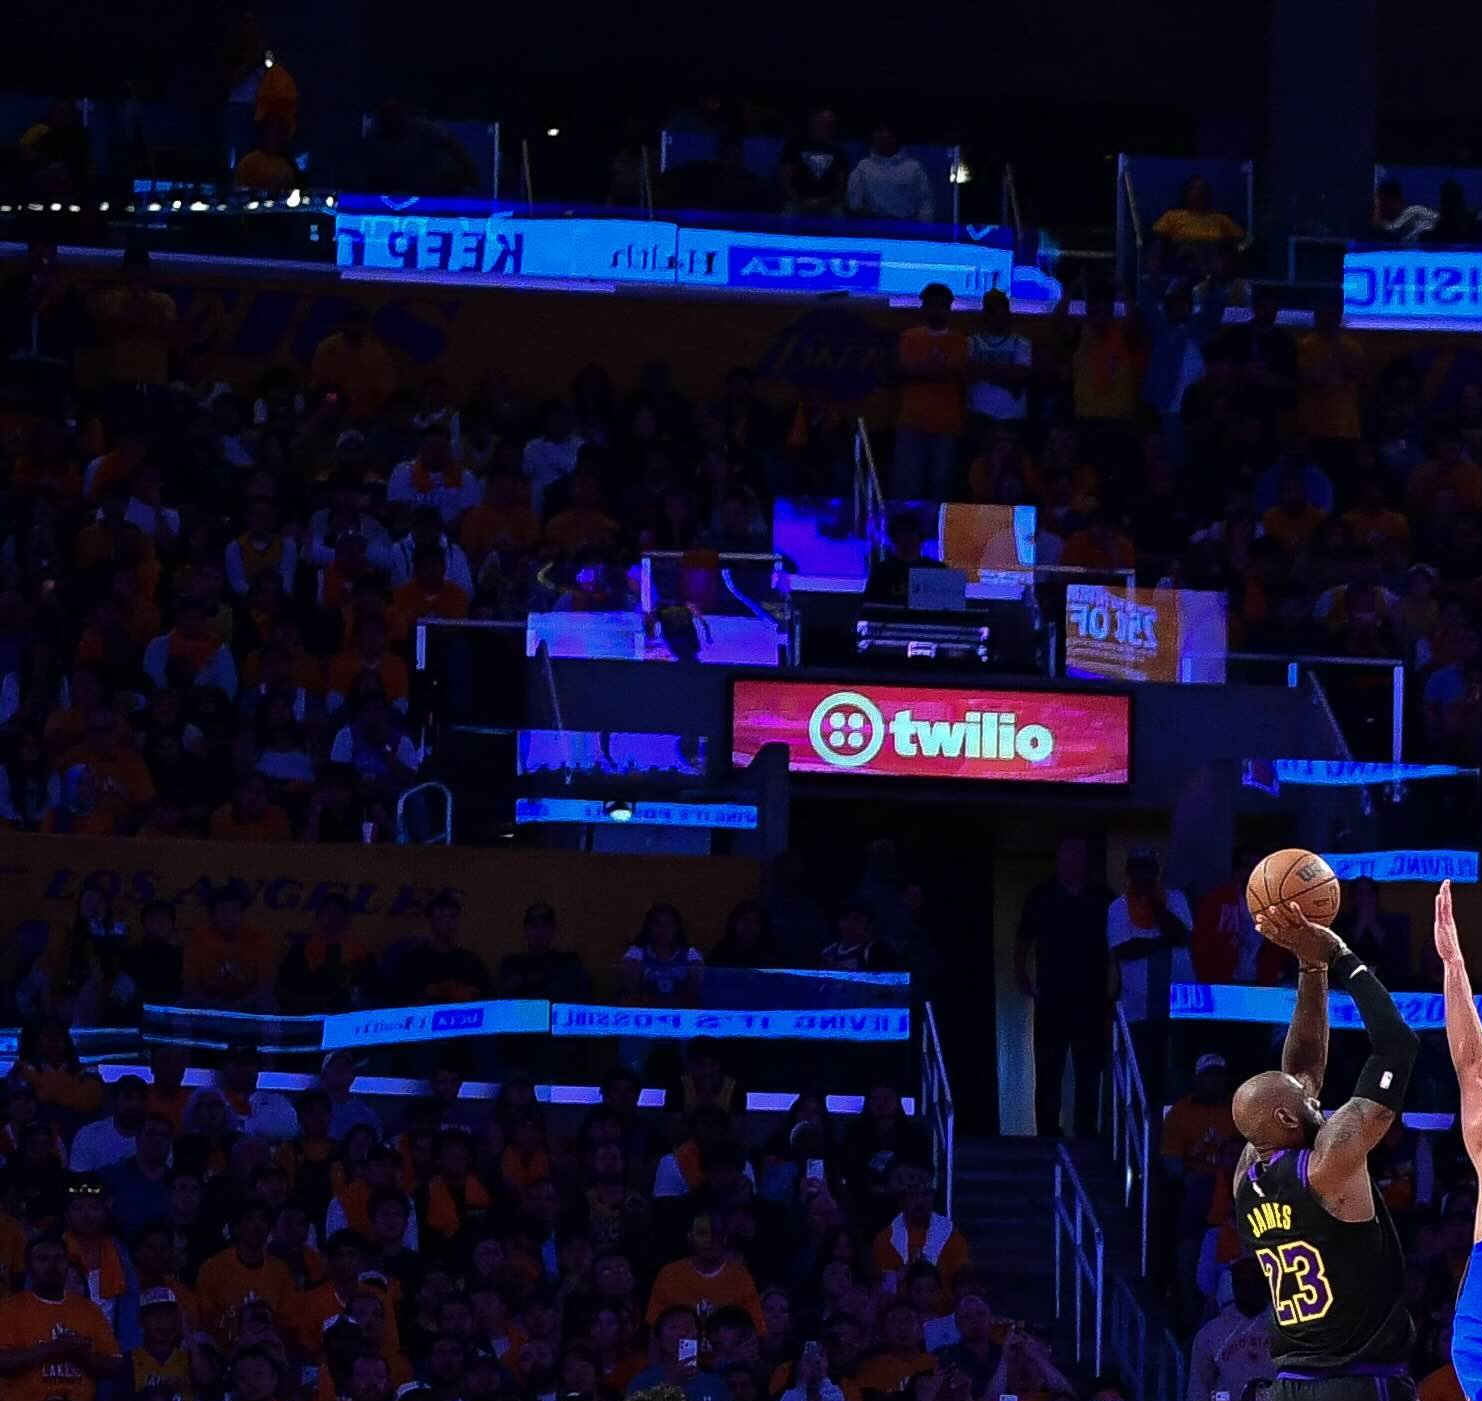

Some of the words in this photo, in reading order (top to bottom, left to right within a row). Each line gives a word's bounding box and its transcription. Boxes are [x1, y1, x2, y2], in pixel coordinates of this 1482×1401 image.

[889, 709, 1055, 763] twilio
[1246, 1201, 1293, 1239] JAMES
[1254, 1239, 1335, 1327] 23
